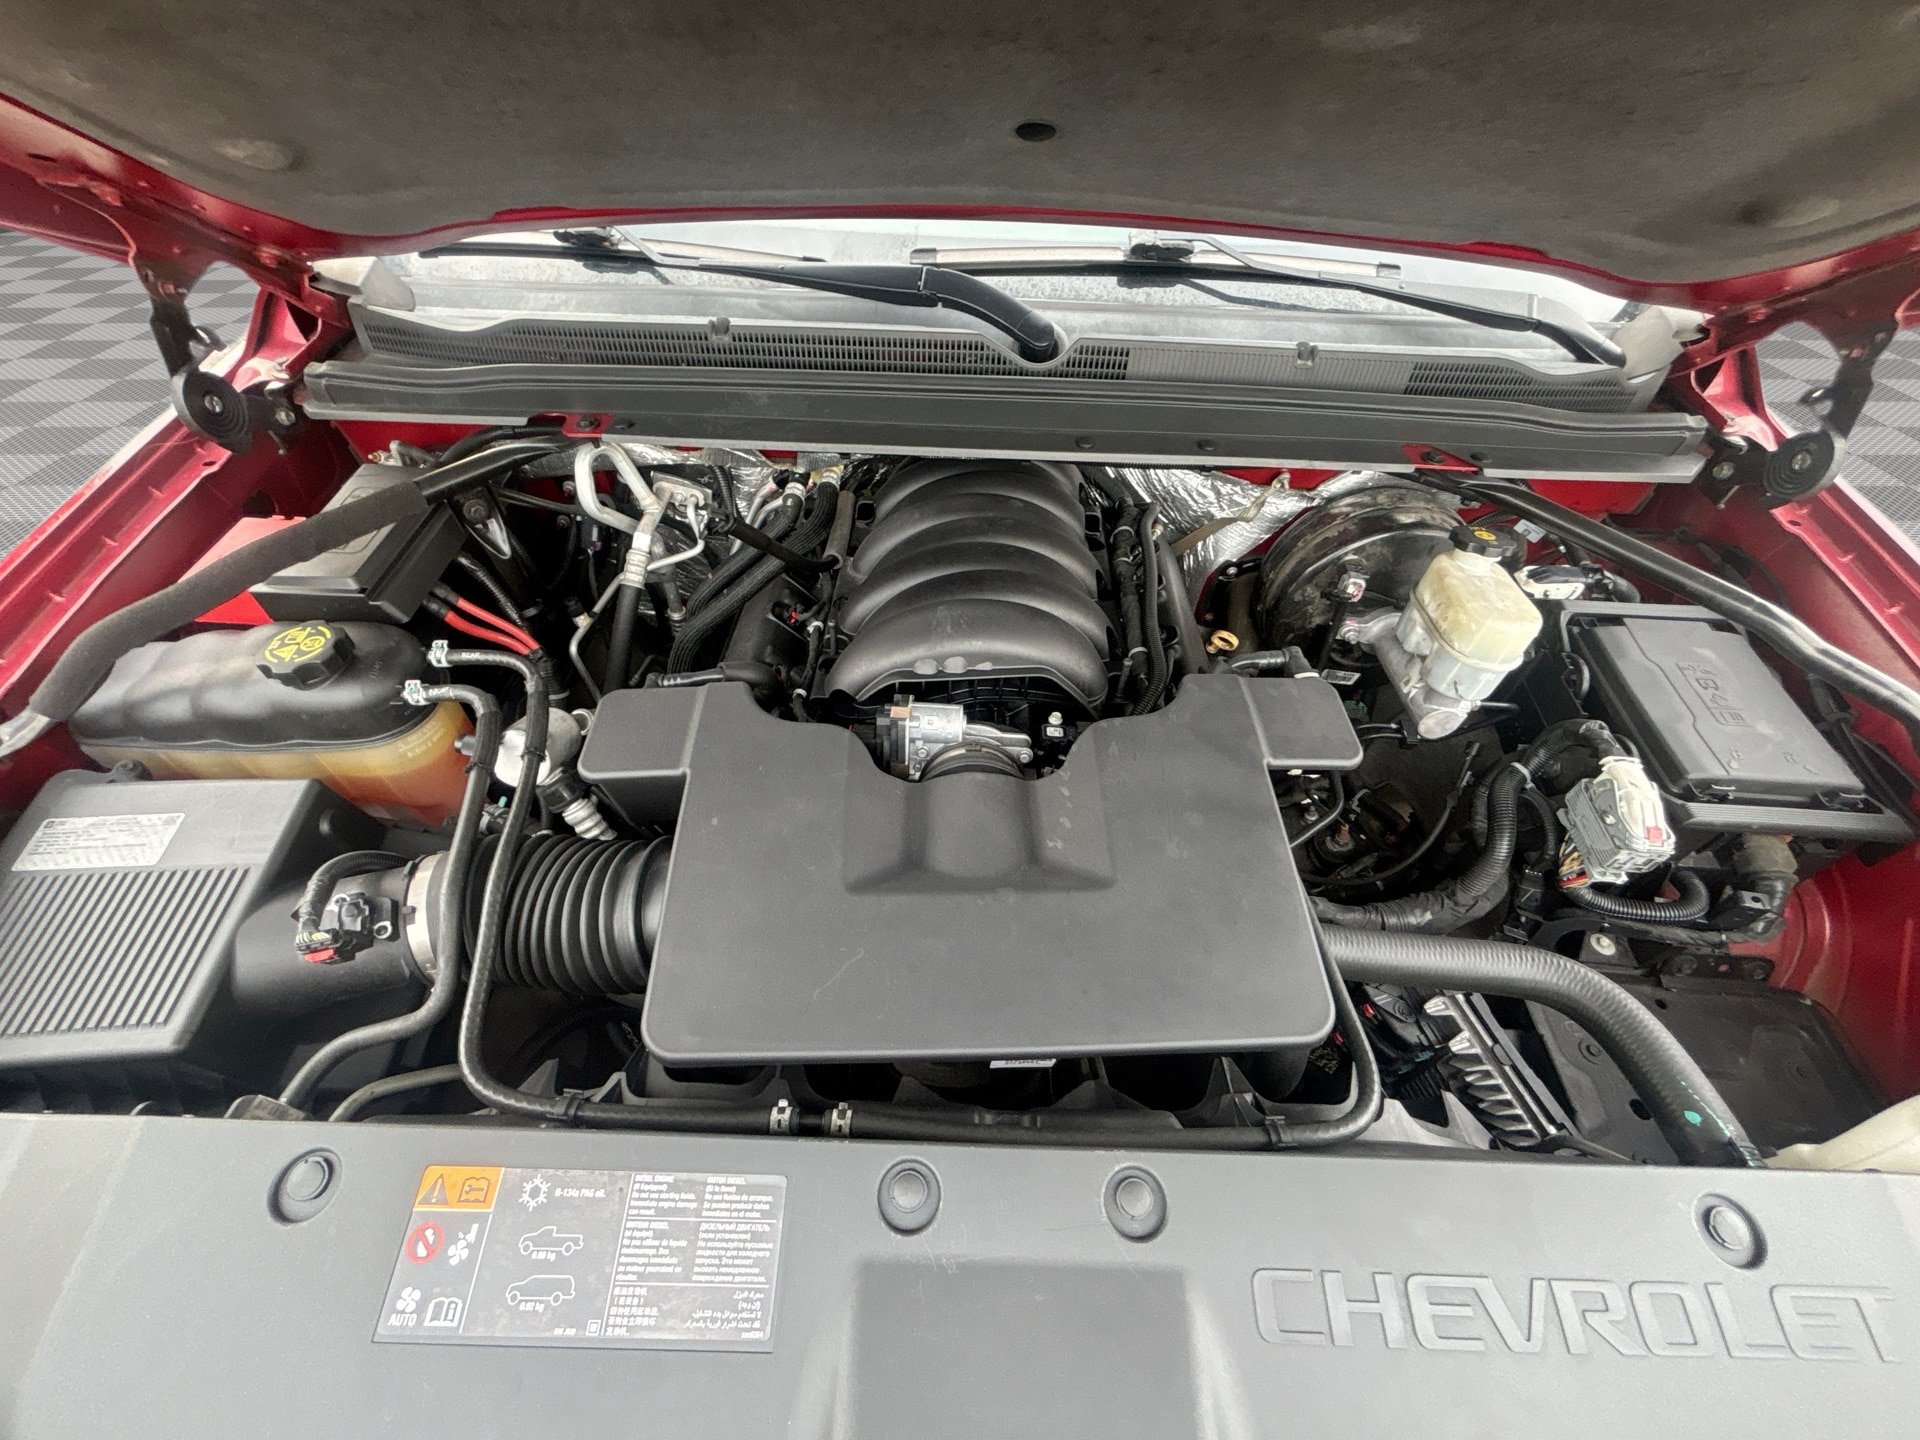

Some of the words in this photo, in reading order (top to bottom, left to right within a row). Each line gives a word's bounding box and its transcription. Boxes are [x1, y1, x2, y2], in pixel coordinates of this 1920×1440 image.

[555, 1188, 579, 1197] R-134a
[580, 1188, 594, 1197] PAG
[388, 1313, 417, 1326] AUTO
[1251, 1267, 1899, 1363] CHEVROLET
